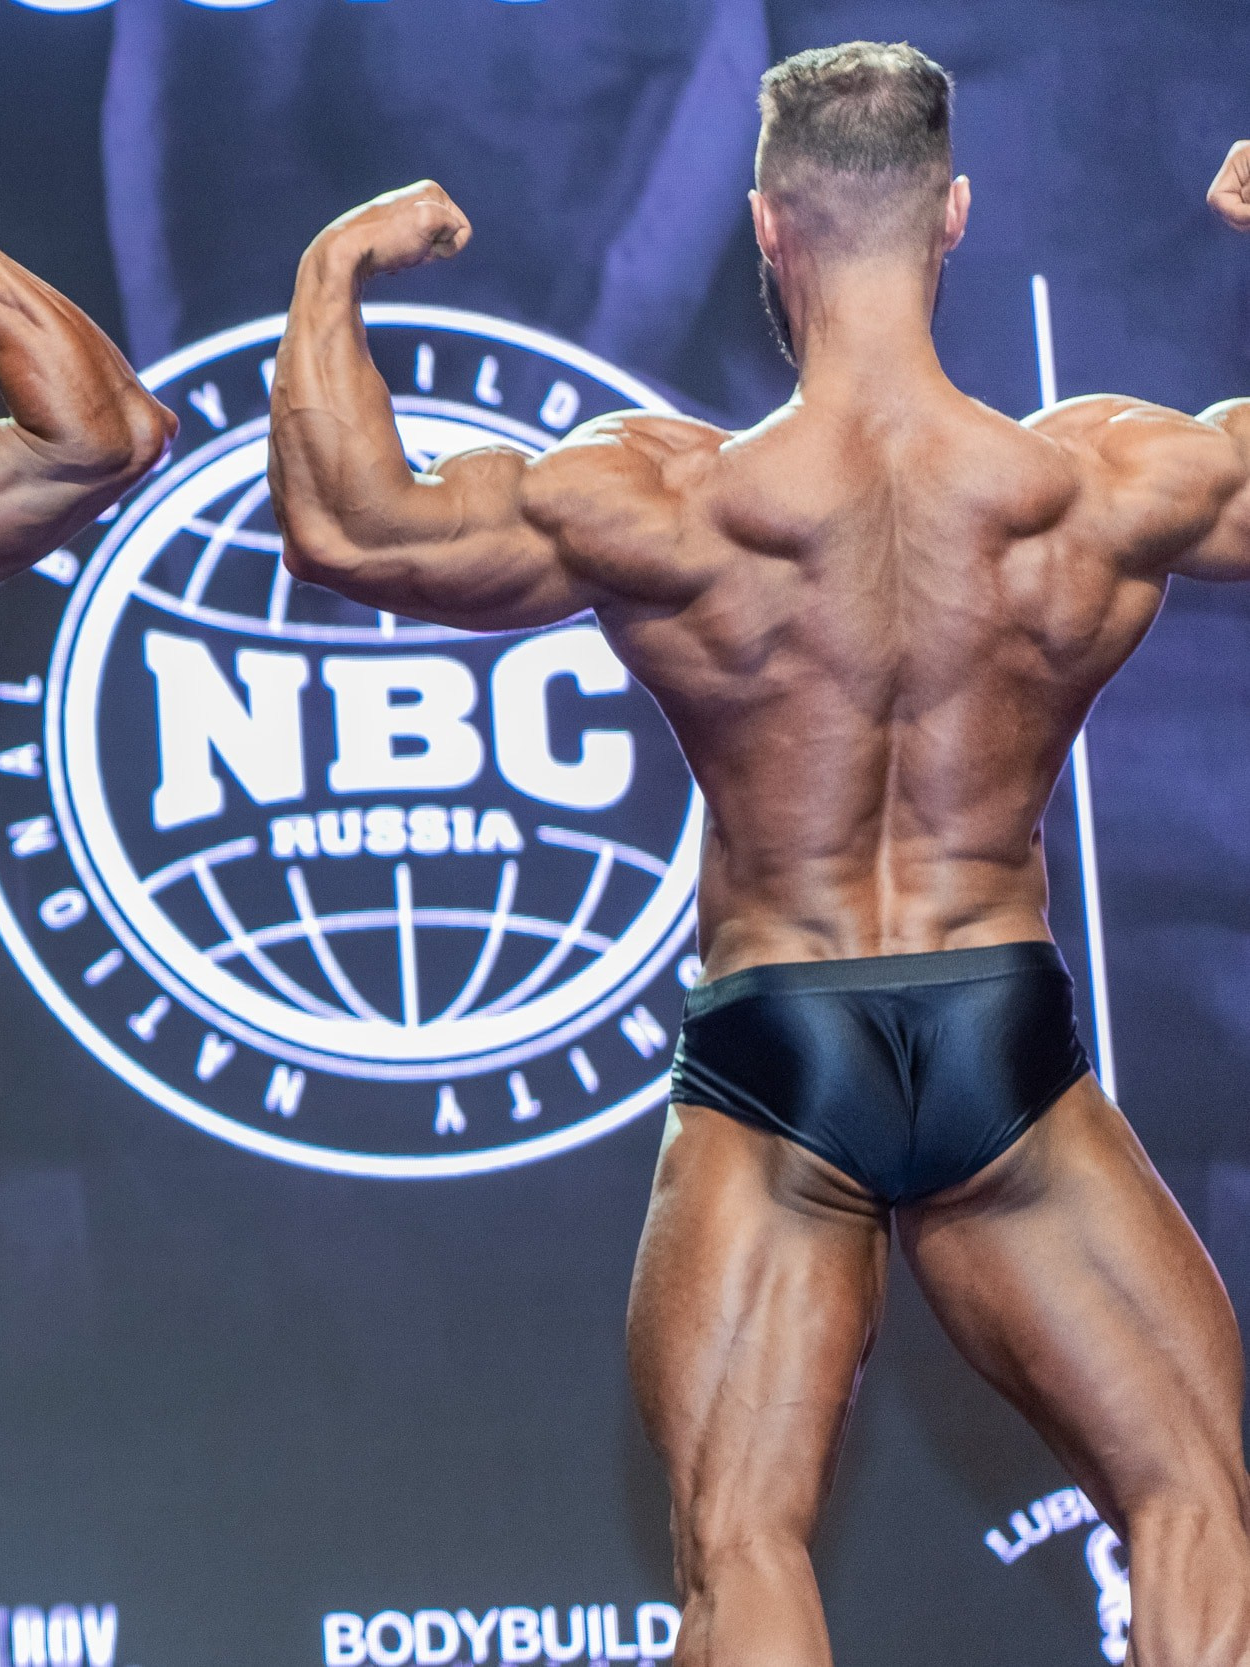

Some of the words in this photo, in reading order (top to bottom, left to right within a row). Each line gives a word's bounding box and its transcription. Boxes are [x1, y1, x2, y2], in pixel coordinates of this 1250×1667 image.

[144, 626, 635, 831] NBC
[270, 804, 524, 859] RUSSIA
[322, 1601, 683, 1667] BODYBUILD
